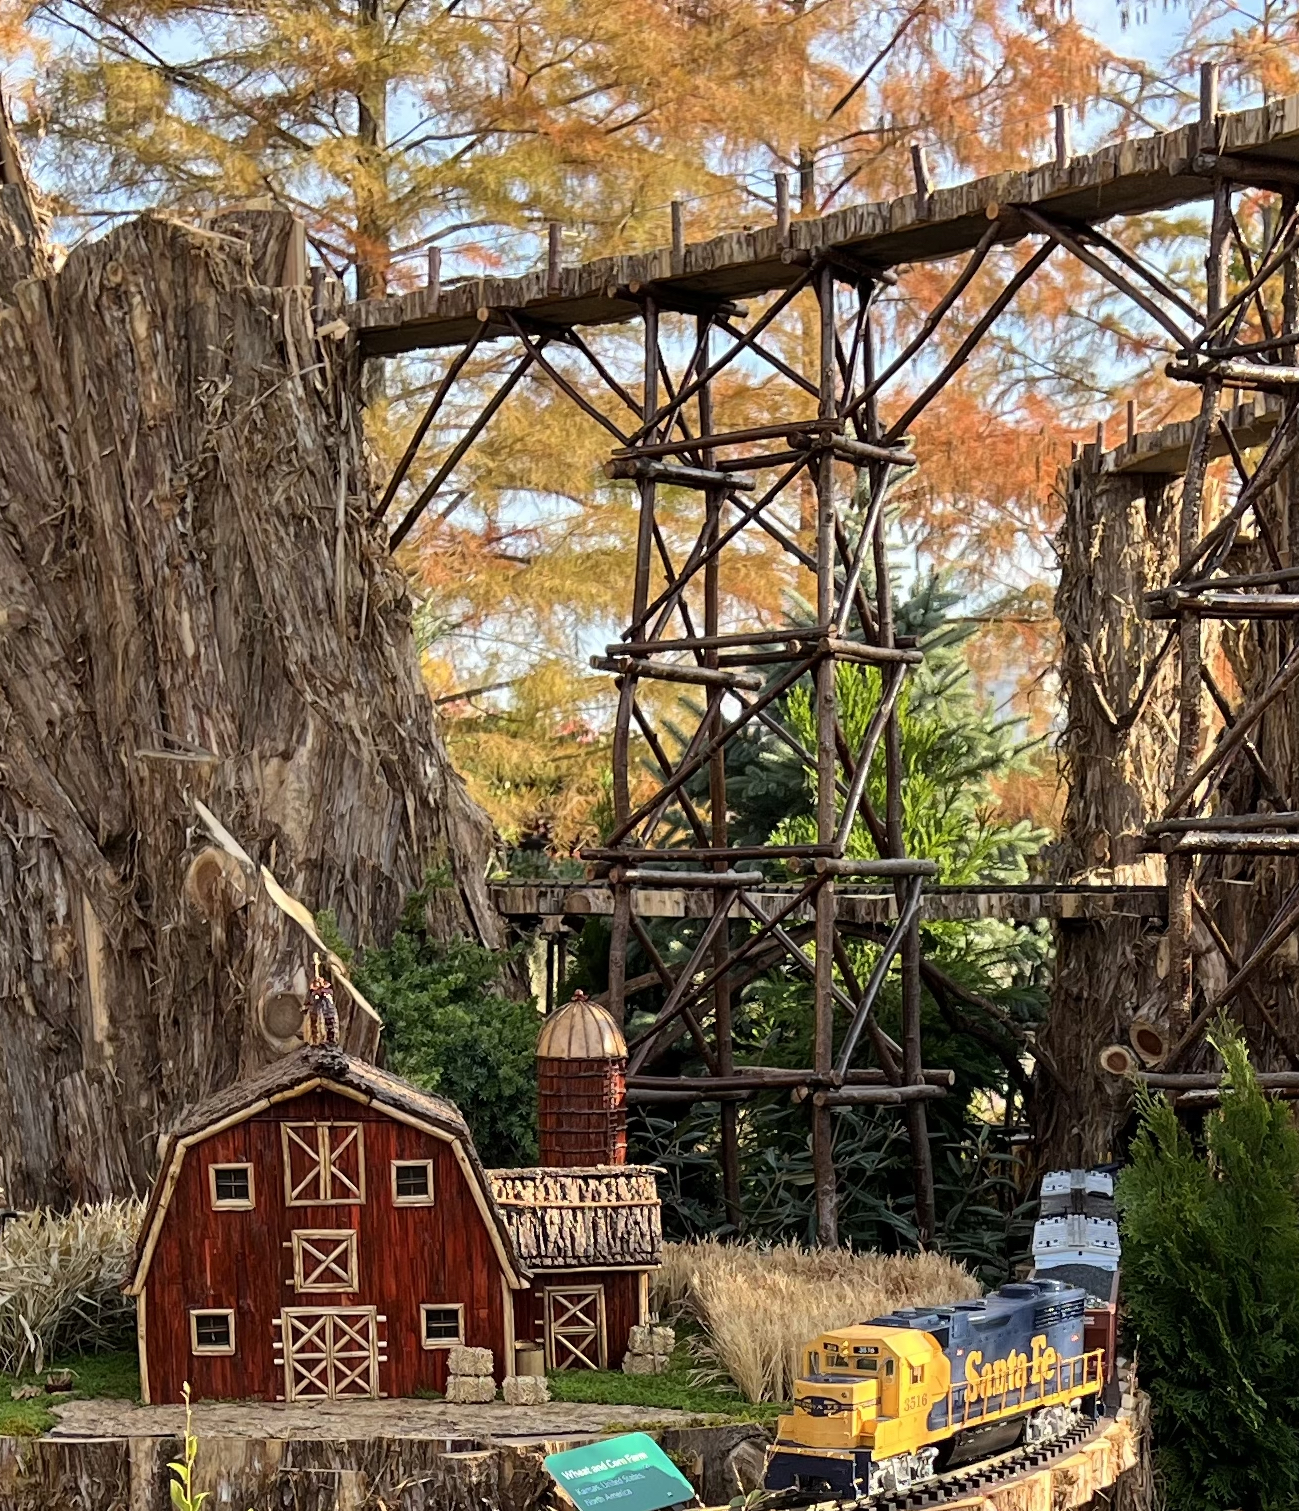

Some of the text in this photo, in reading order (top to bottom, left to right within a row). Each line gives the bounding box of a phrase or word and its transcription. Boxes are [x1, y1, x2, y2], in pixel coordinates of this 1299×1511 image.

[964, 1334, 1057, 1402] Santa Fe
[903, 1393, 928, 1412] 3516
[561, 1452, 648, 1481] Wheat and Corn Farm
[600, 1477, 624, 1489] United
[583, 1488, 633, 1507] North America
